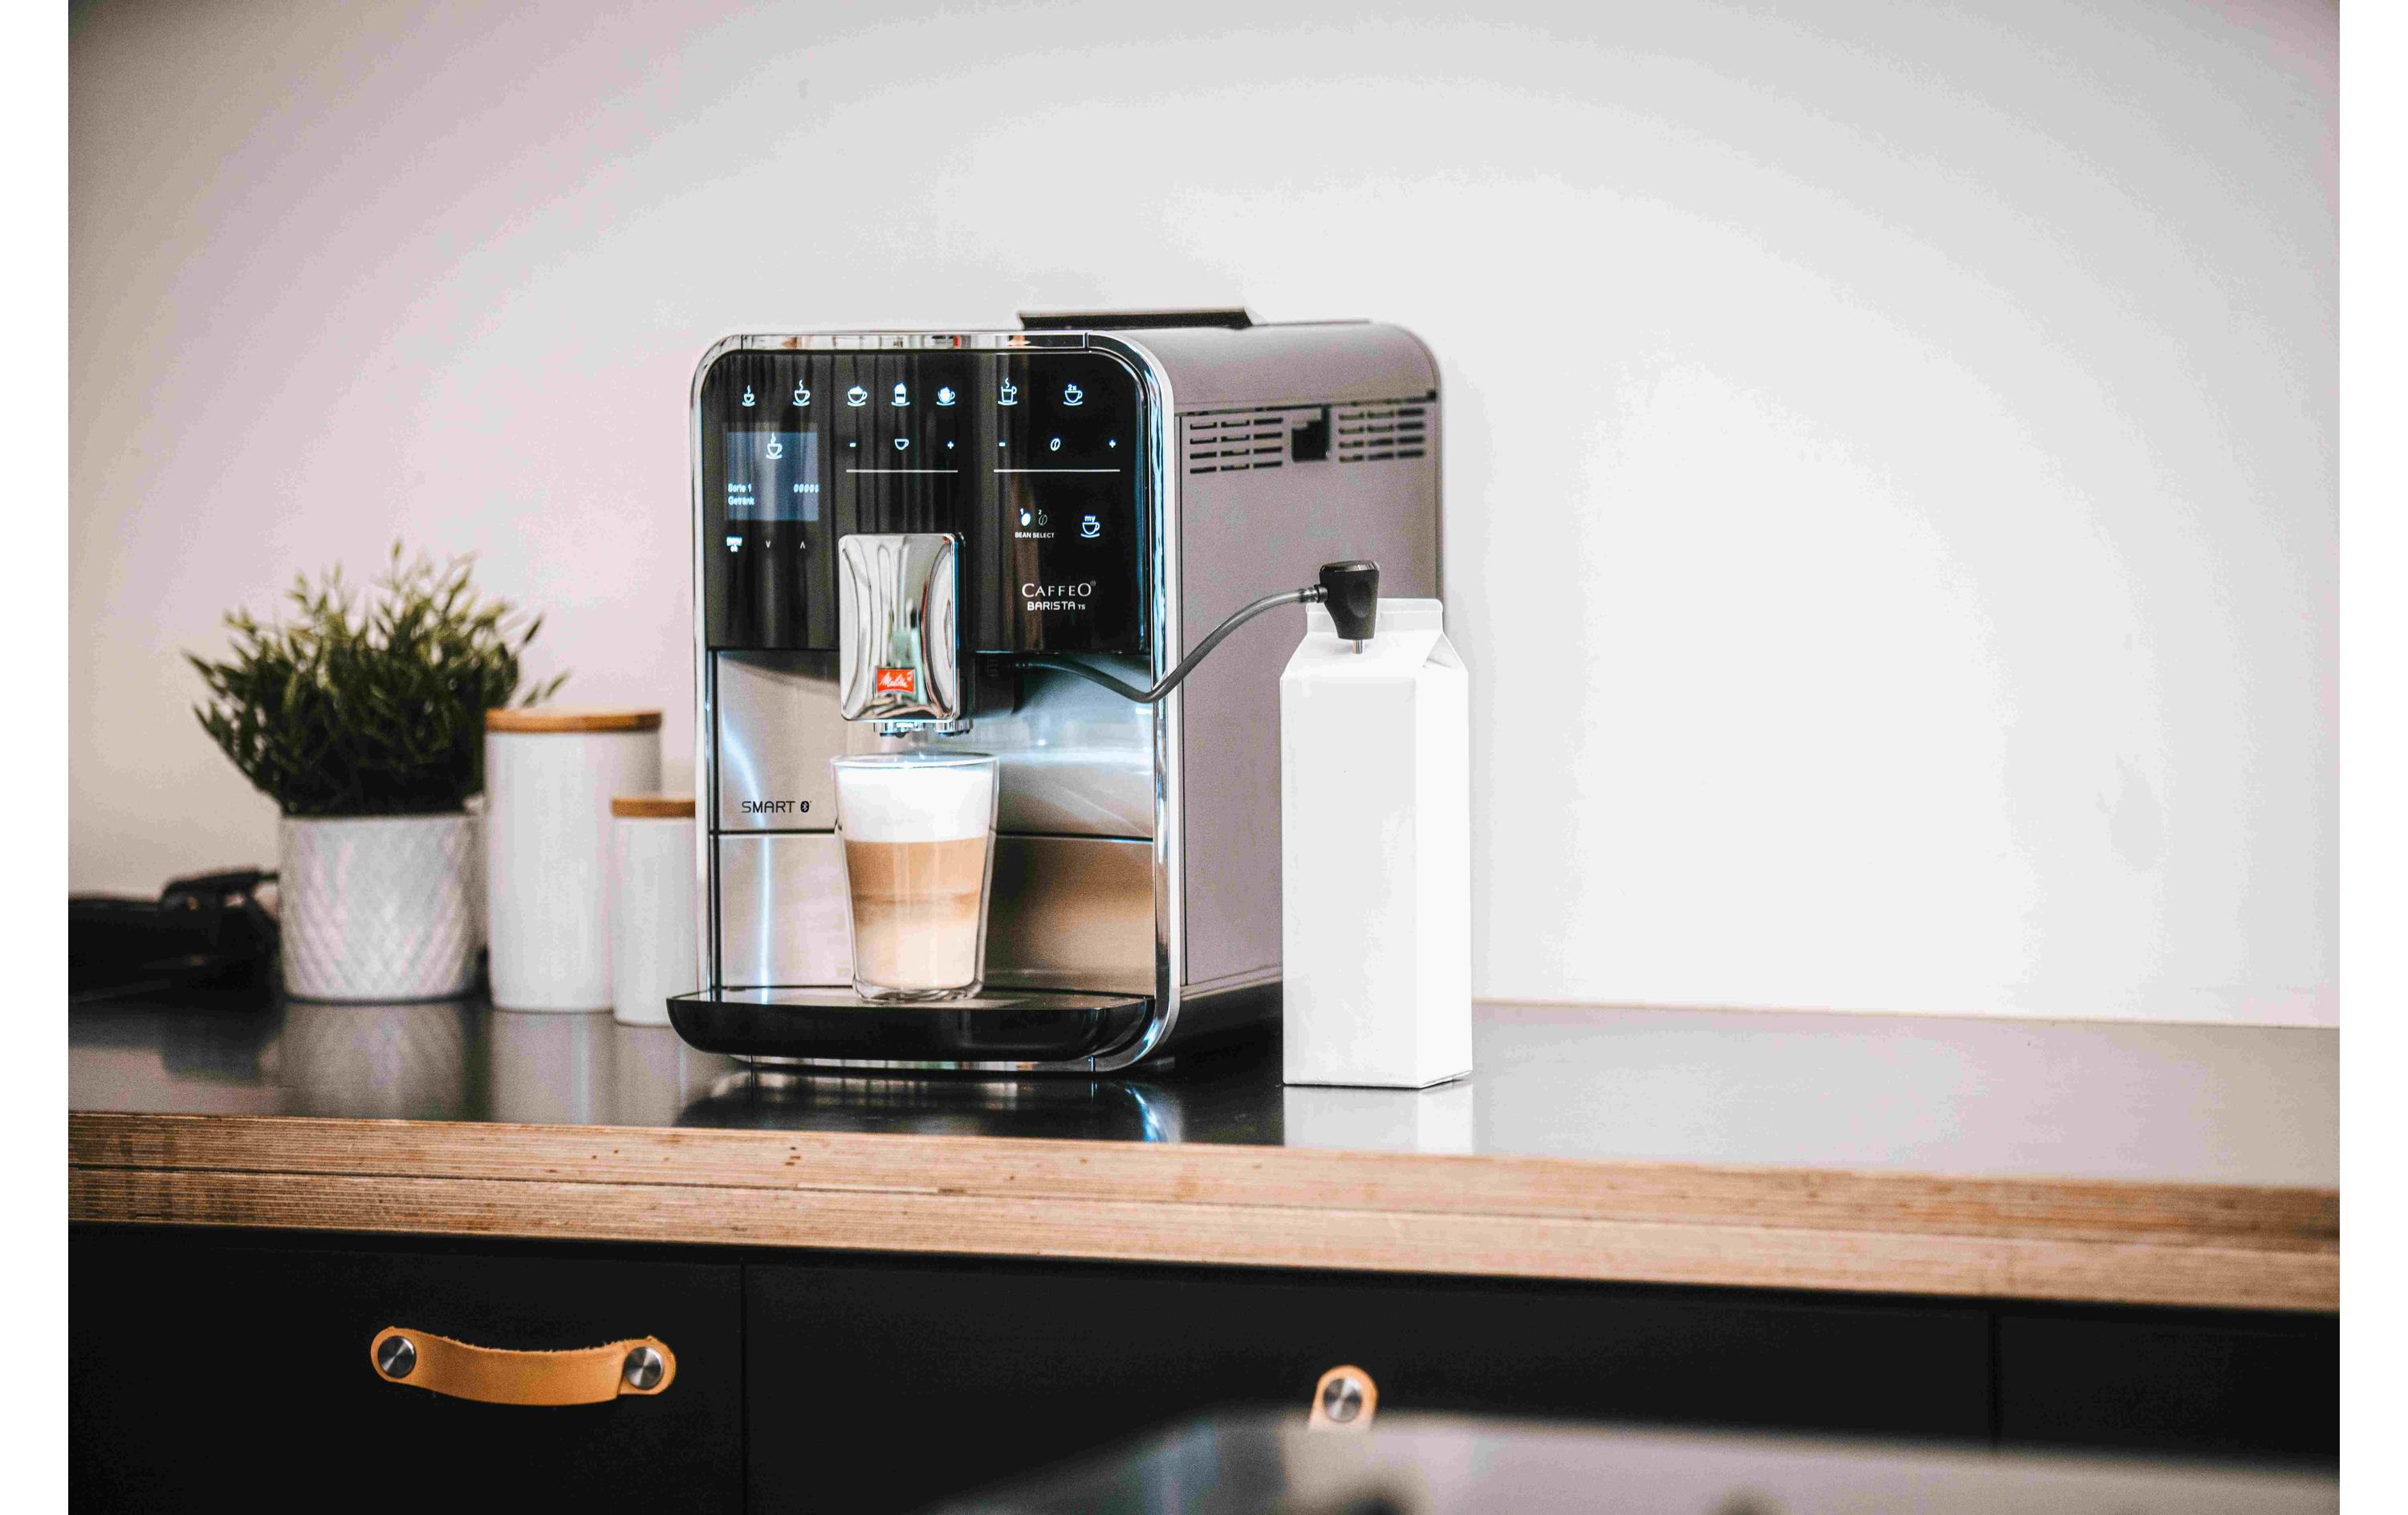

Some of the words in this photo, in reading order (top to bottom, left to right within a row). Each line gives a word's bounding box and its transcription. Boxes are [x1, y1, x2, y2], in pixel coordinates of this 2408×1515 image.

[748, 483, 752, 493] 1
[1084, 515, 1096, 523] my
[1027, 601, 1076, 611] BARISTA
[741, 801, 796, 814] SMART
